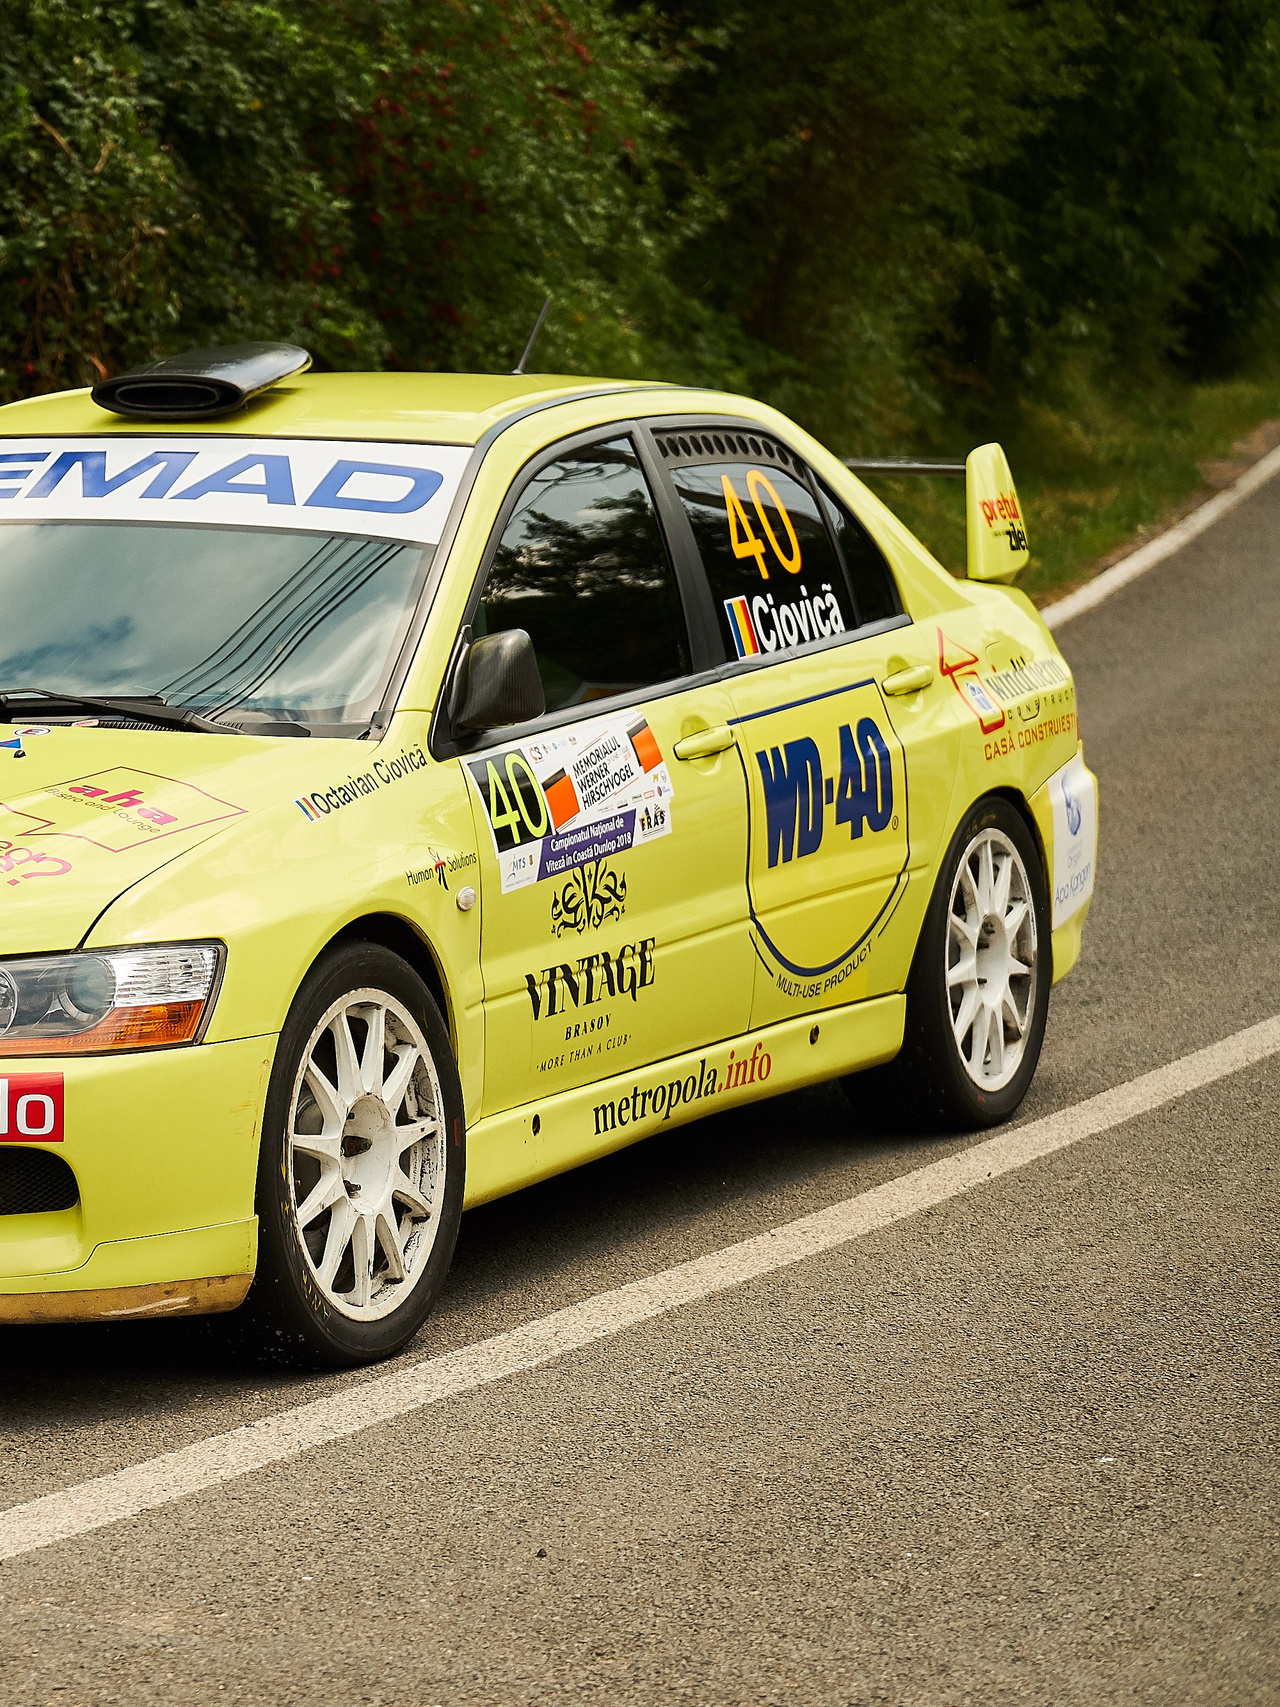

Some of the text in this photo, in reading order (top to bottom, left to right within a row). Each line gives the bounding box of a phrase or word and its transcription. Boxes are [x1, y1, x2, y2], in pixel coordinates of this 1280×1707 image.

[720, 469, 803, 580] 40
[572, 735, 621, 779] MEMORIALUL
[984, 728, 1016, 761] CASĂ
[310, 773, 380, 815] Octavian
[486, 752, 548, 845] 40
[577, 762, 611, 794] WERNER
[582, 763, 635, 810] HIRSCHVOGEL
[755, 717, 894, 869] WD-40
[68, 784, 179, 826] aha
[550, 824, 590, 852] Campionatul
[616, 816, 624, 829] de
[594, 838, 617, 857] Dunlop
[616, 832, 632, 849] 2018
[404, 852, 477, 886] Human Solutions
[524, 937, 655, 1021] VINTAGE
[776, 939, 873, 998] MULTI-USE PRODUCT
[565, 1013, 612, 1040] BRASOV
[569, 1045, 594, 1063] THAN
[596, 1042, 602, 1053] A
[593, 1042, 772, 1136] metropola.info
